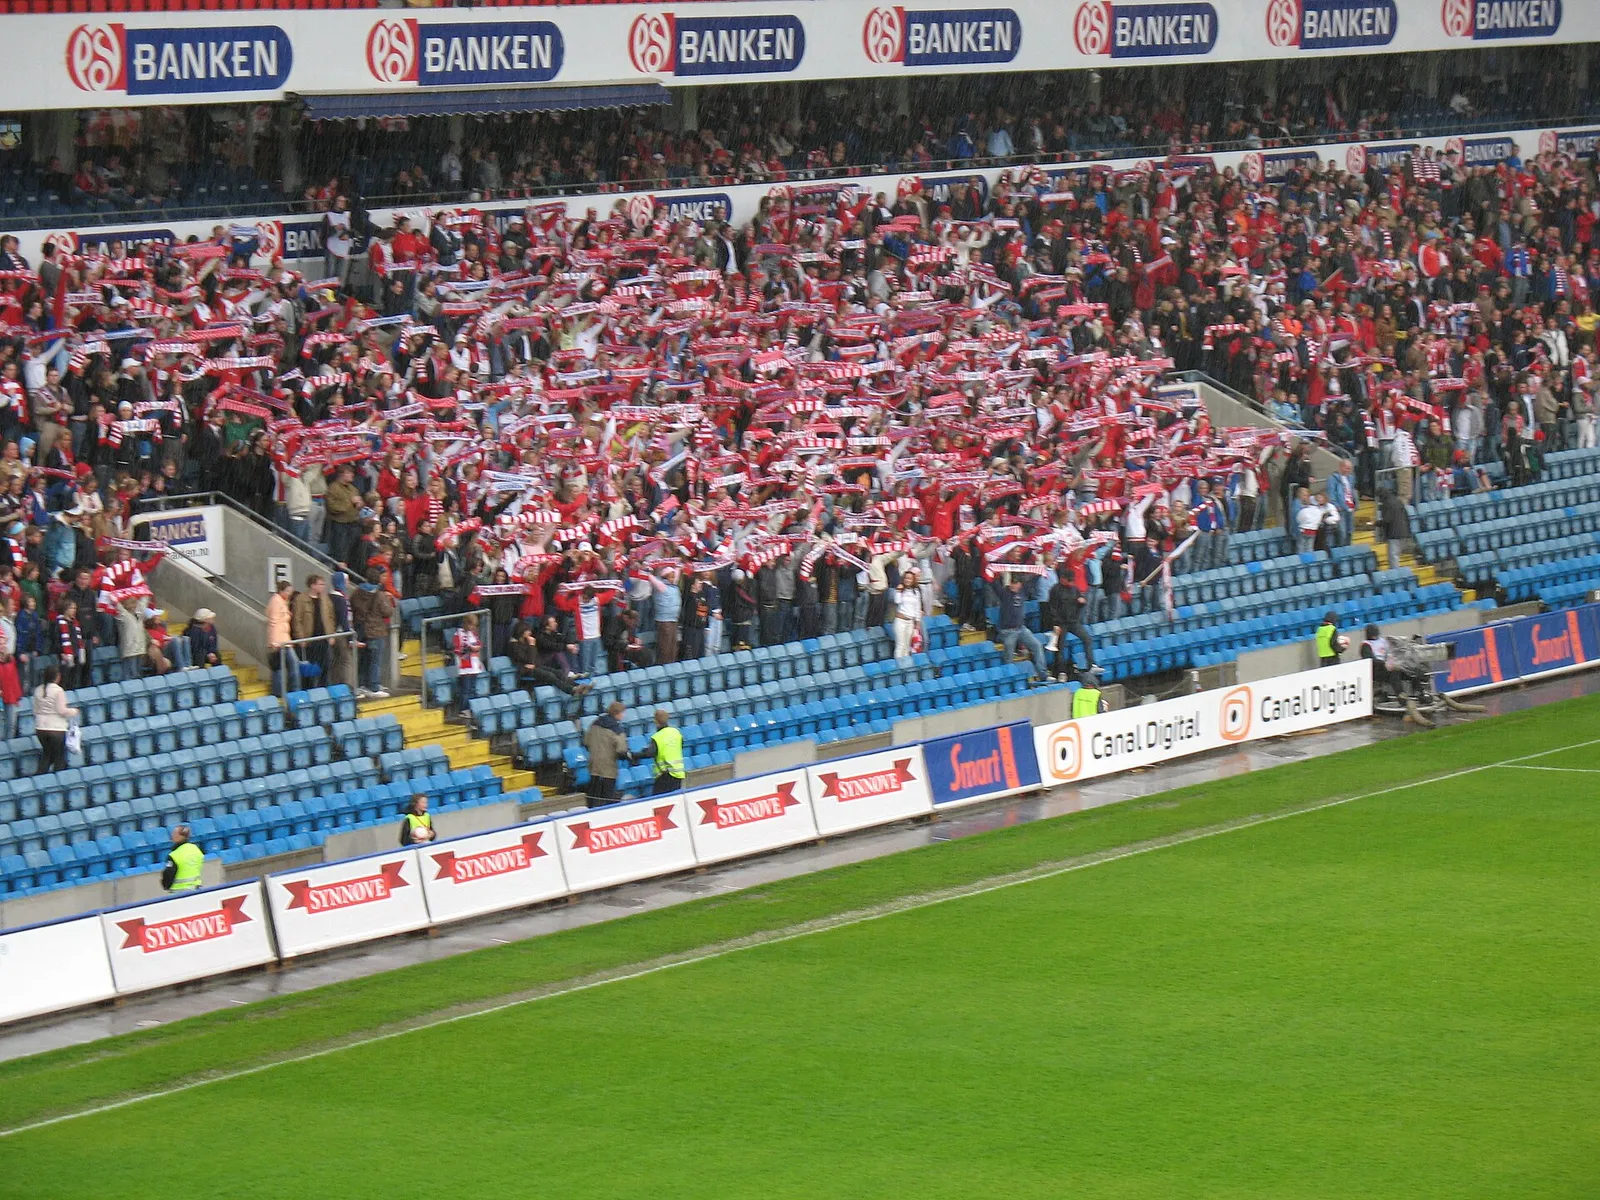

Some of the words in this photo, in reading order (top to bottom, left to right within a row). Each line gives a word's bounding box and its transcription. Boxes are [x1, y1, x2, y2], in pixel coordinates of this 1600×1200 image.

[1115, 14, 1210, 47] BANKEN
[1303, 7, 1391, 39] BANKEN
[1475, 0, 1556, 30] BANKEN
[424, 34, 552, 73] BANKEN
[680, 28, 795, 64] BANKEN
[909, 21, 1013, 54] BANKEN
[133, 40, 278, 82] BANKEN
[669, 200, 727, 222] ANKE
[1261, 687, 1308, 723] Canal
[1311, 676, 1362, 714] Digital
[1091, 730, 1142, 760] Canal
[1146, 710, 1201, 751] Digital
